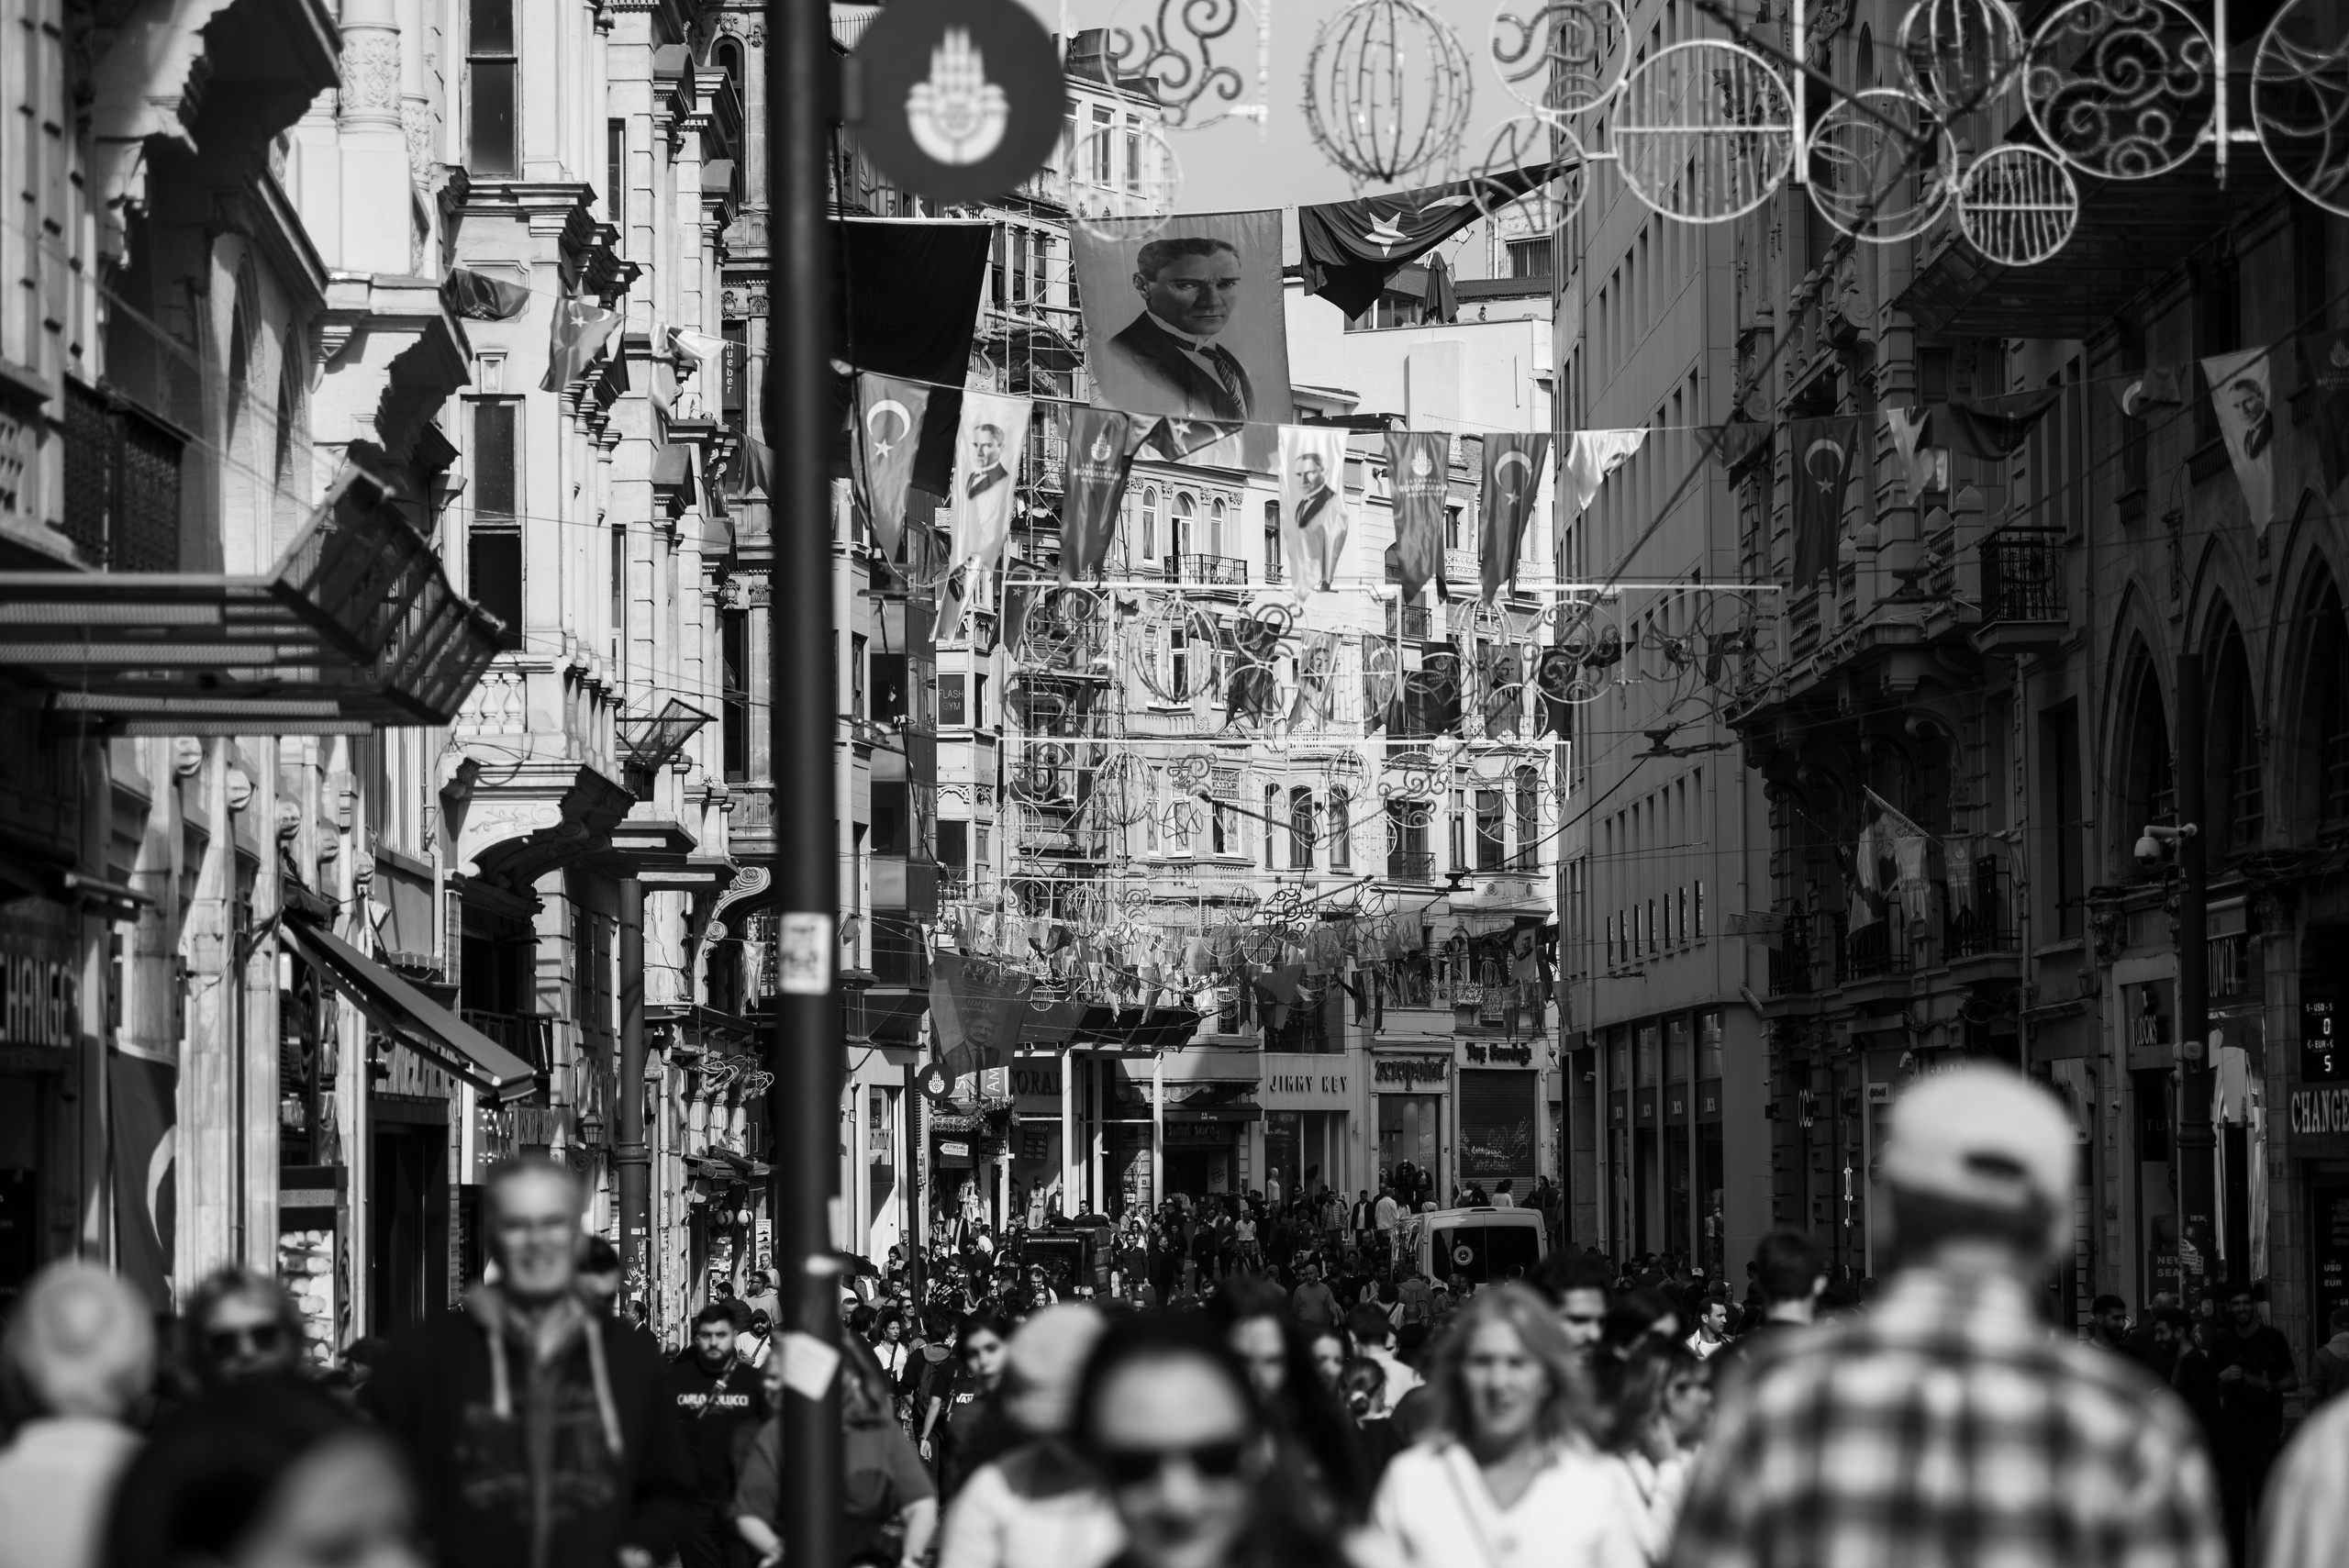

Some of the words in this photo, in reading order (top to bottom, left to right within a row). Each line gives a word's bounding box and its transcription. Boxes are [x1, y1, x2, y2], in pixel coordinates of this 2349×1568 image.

[938, 688, 964, 699] FLASH
[942, 701, 961, 711] GYM
[2131, 1015, 2157, 1048] TUDORS
[1270, 1075, 1314, 1092] JIMMY
[1322, 1075, 1349, 1092] KEY
[2291, 1089, 2349, 1134] CHANGE
[2323, 1263, 2342, 1272] USD
[2323, 1279, 2342, 1287] EUR
[677, 1393, 707, 1406] CARLO
[712, 1394, 749, 1407] OLUCCI
[956, 1393, 974, 1404] VAN
